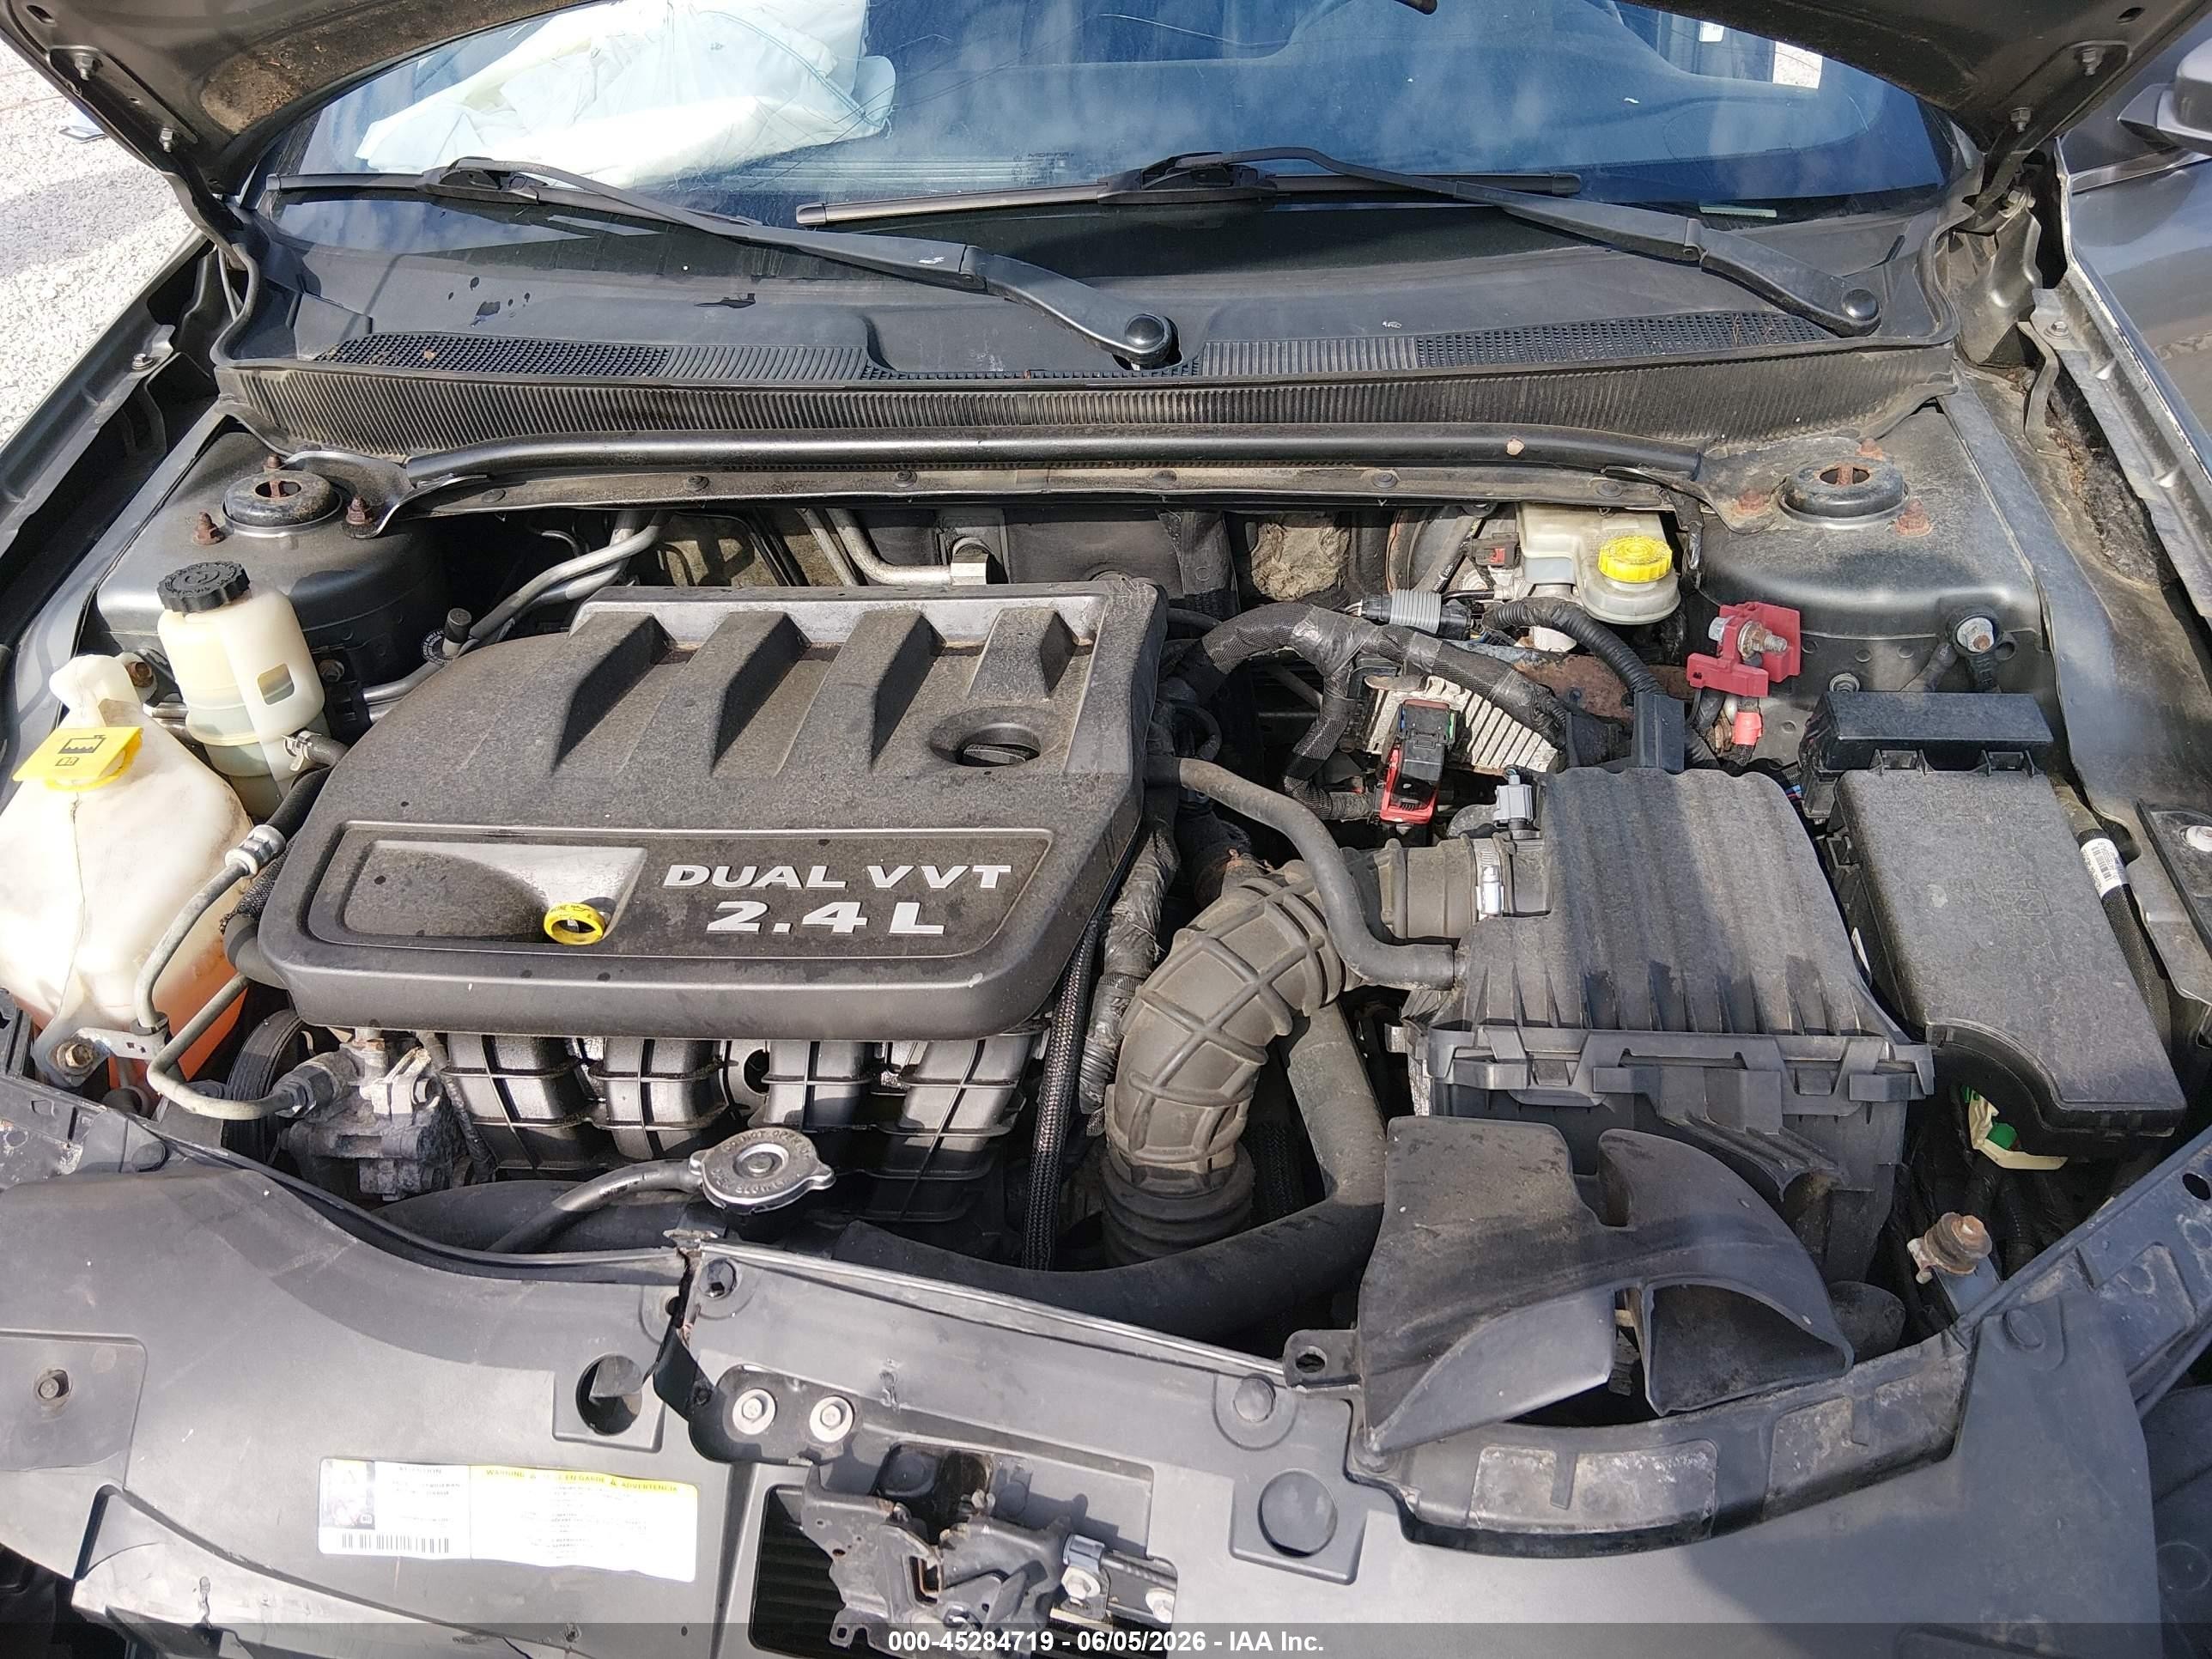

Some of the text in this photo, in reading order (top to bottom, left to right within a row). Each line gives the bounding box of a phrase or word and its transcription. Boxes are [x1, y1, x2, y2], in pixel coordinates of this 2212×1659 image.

[663, 865, 1012, 889] DUAL VVT
[706, 901, 945, 934] 2.4 L
[739, 1130, 766, 1142] NOT
